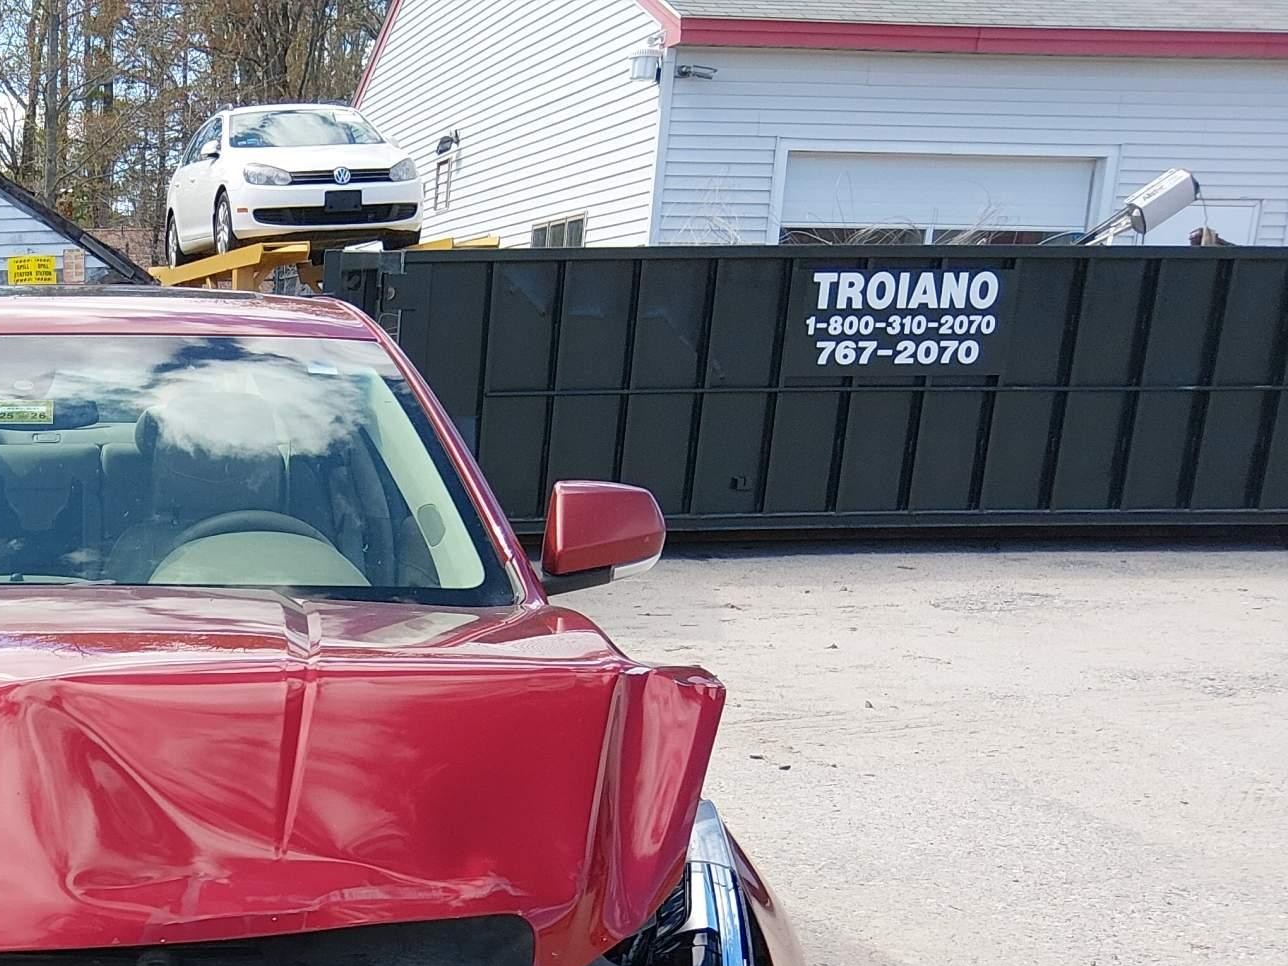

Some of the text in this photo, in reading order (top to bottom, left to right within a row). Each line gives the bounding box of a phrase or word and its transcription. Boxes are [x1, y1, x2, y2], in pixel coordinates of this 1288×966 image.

[813, 271, 999, 310] TROIANO
[805, 314, 996, 336] 1-800-310-2070
[816, 339, 980, 366] 767-2070
[0, 412, 47, 420] 25 26
